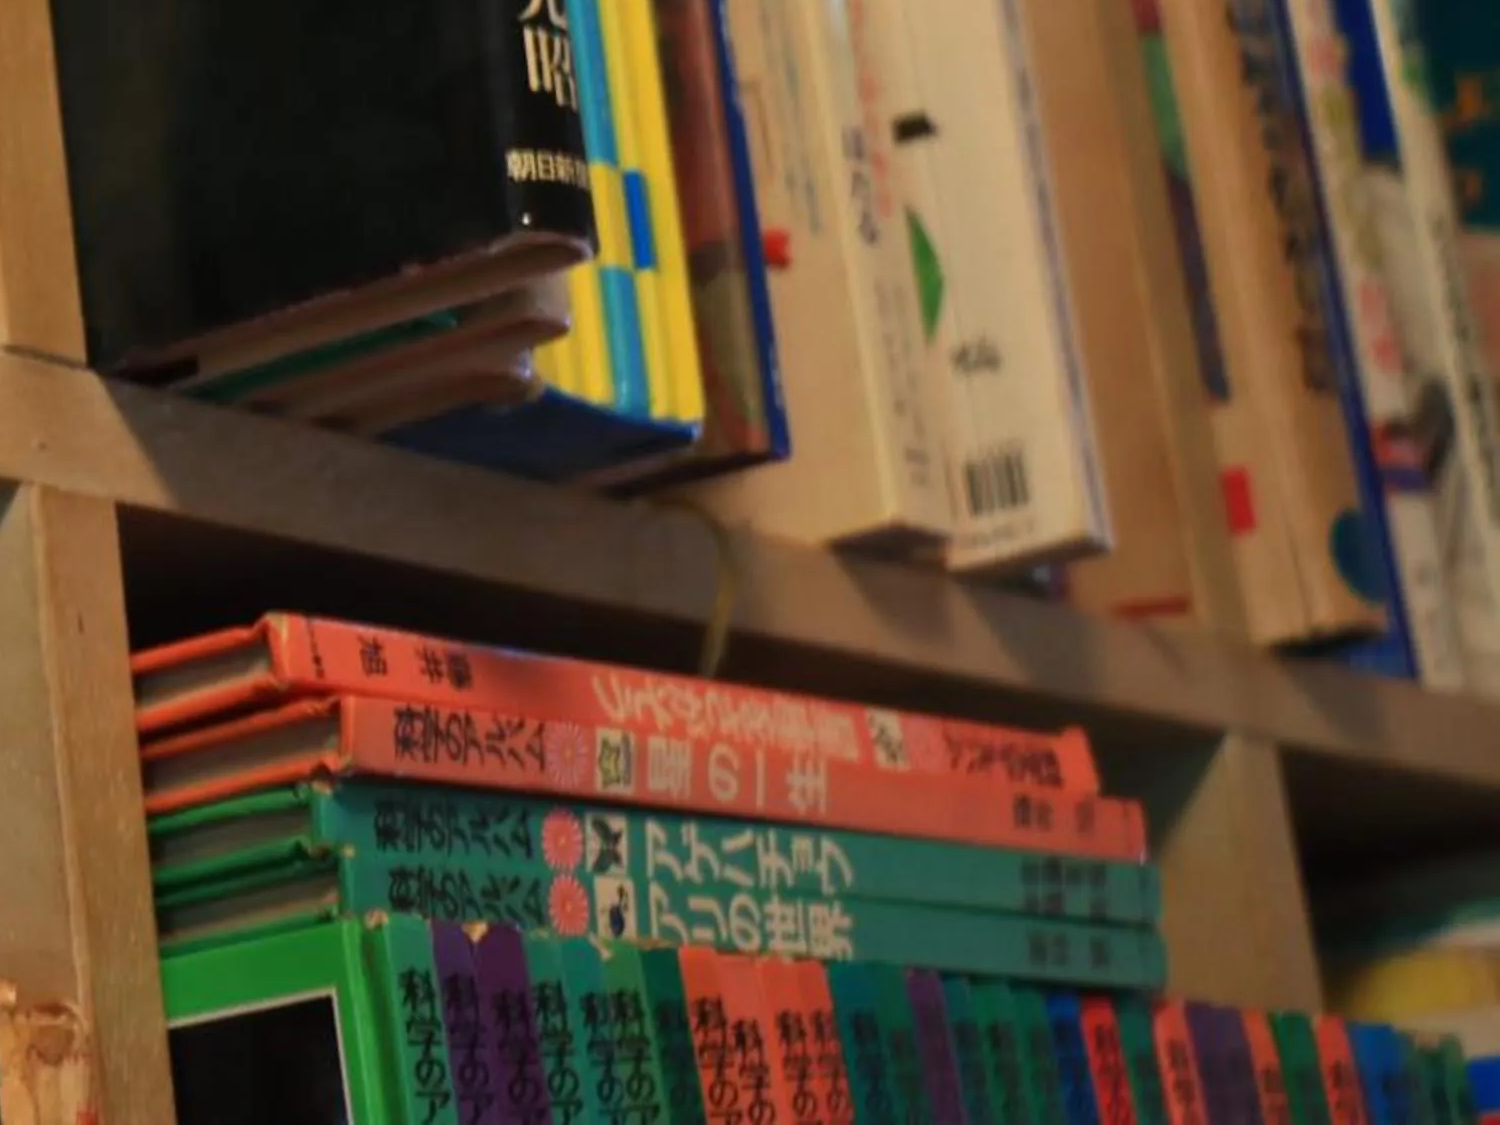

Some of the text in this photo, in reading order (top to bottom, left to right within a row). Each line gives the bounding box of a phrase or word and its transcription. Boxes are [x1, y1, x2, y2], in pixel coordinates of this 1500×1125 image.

[394, 707, 830, 813] 科学のアルバム 星の一生
[373, 797, 854, 894] 科学のアルバム アゲハチョウ
[388, 863, 855, 963] 科学のアルバム アリの世界
[778, 1009, 825, 1125] 科学の
